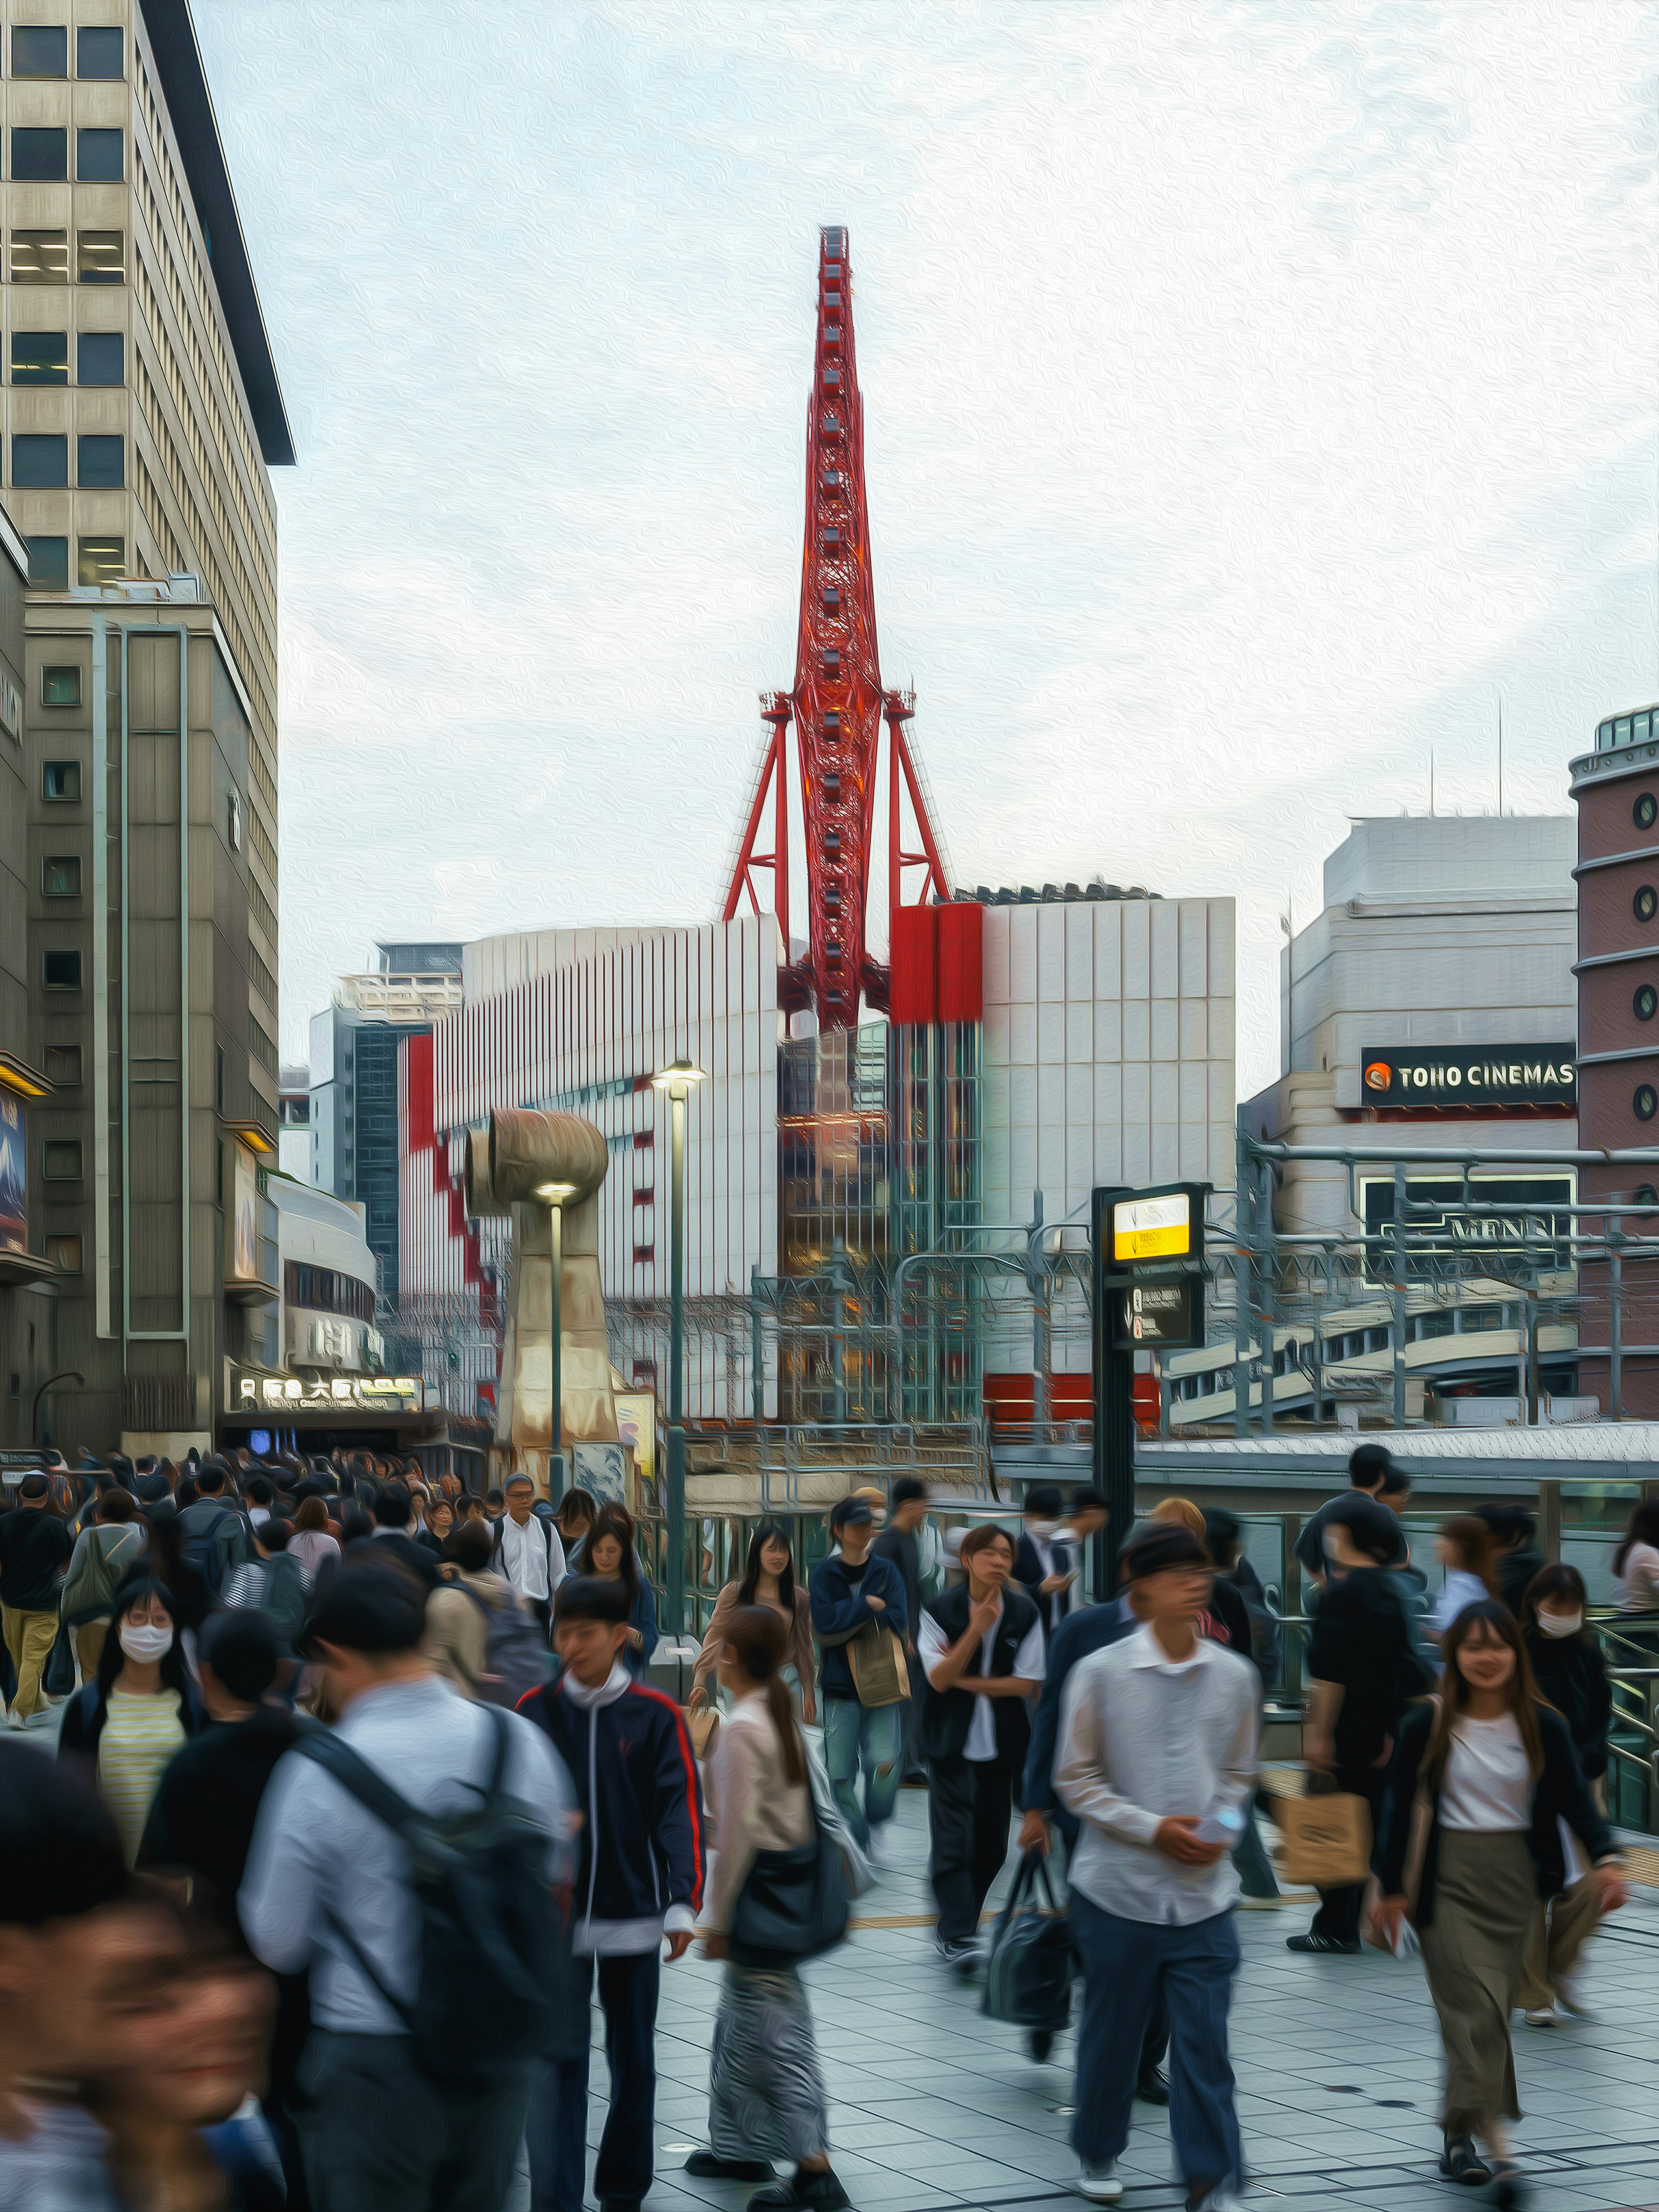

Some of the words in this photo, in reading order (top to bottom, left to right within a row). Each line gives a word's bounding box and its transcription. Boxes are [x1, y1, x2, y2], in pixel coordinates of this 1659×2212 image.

[1398, 1067, 1462, 1087] TOHO
[1467, 1064, 1574, 1086] CINEMAS
[267, 1399, 299, 1409] Hankyu
[358, 1398, 388, 1407] Station
